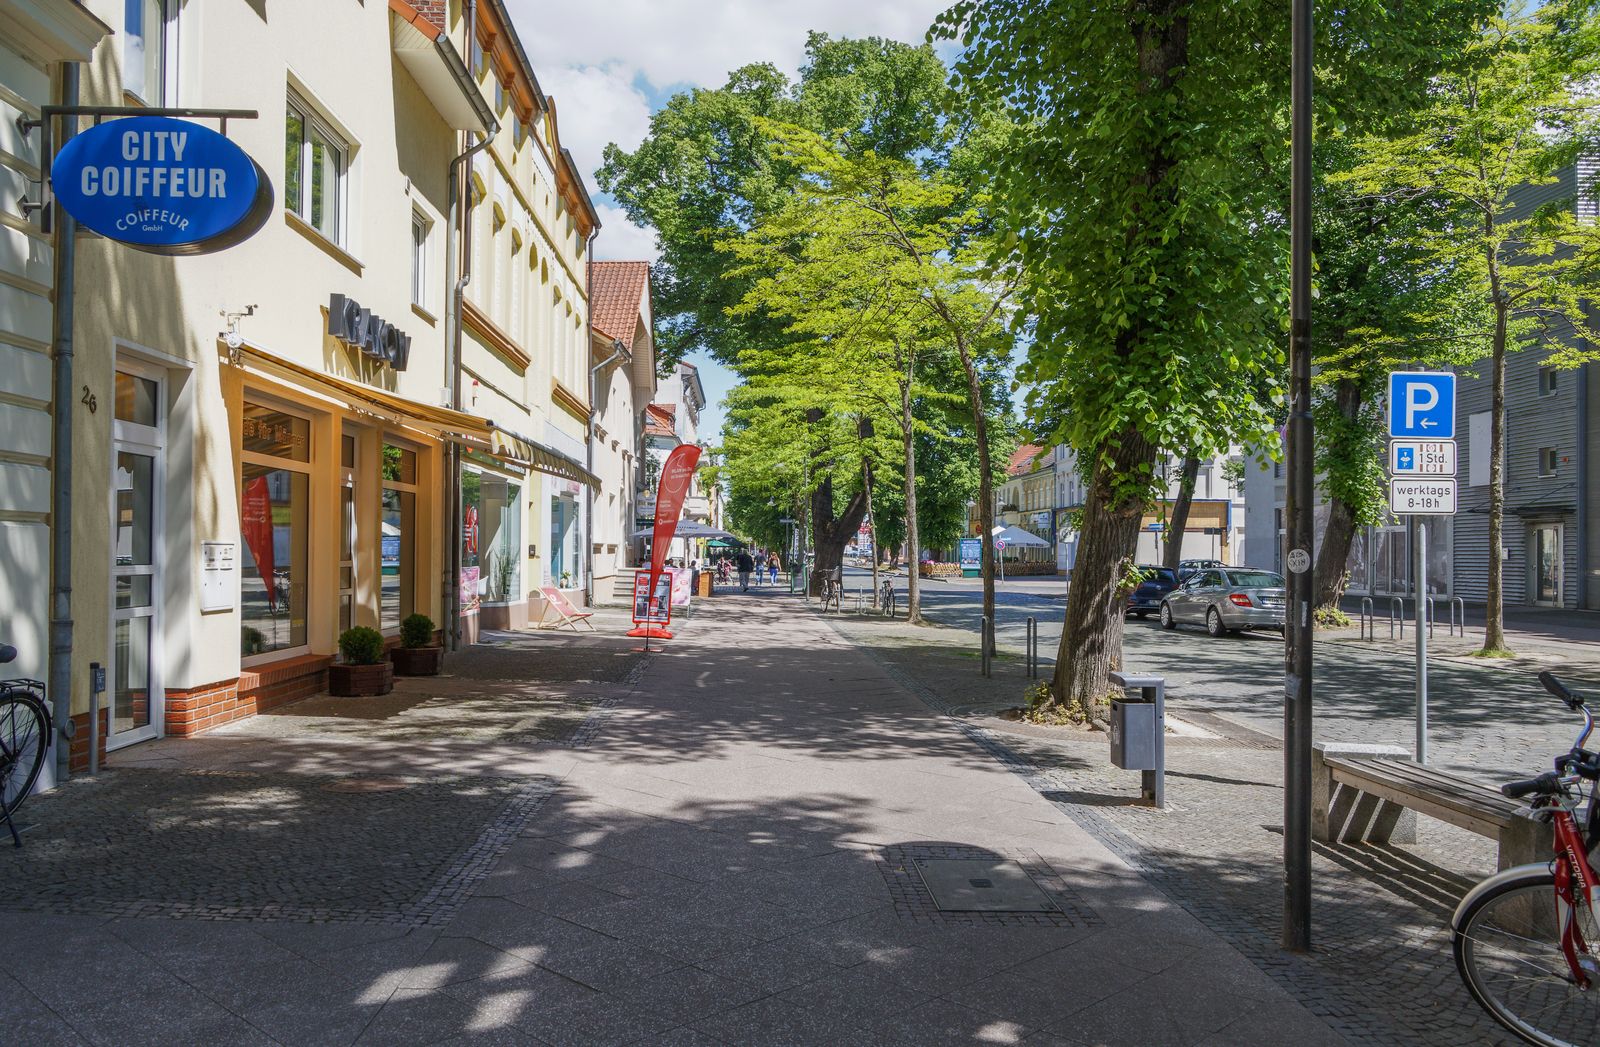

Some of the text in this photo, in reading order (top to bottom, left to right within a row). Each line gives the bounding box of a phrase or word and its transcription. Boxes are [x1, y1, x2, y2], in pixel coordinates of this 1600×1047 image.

[122, 131, 188, 162] CITY
[81, 167, 226, 198] COIFFEUR
[116, 208, 190, 232] COIFFEUR
[142, 224, 164, 232] GmbH
[81, 385, 97, 414] 26
[1405, 382, 1439, 429] P
[1419, 453, 1448, 463] 1 Std.
[1397, 485, 1451, 497] werktags
[1408, 498, 1440, 508] 8-18 h
[1566, 844, 1587, 889] VICTORIA
